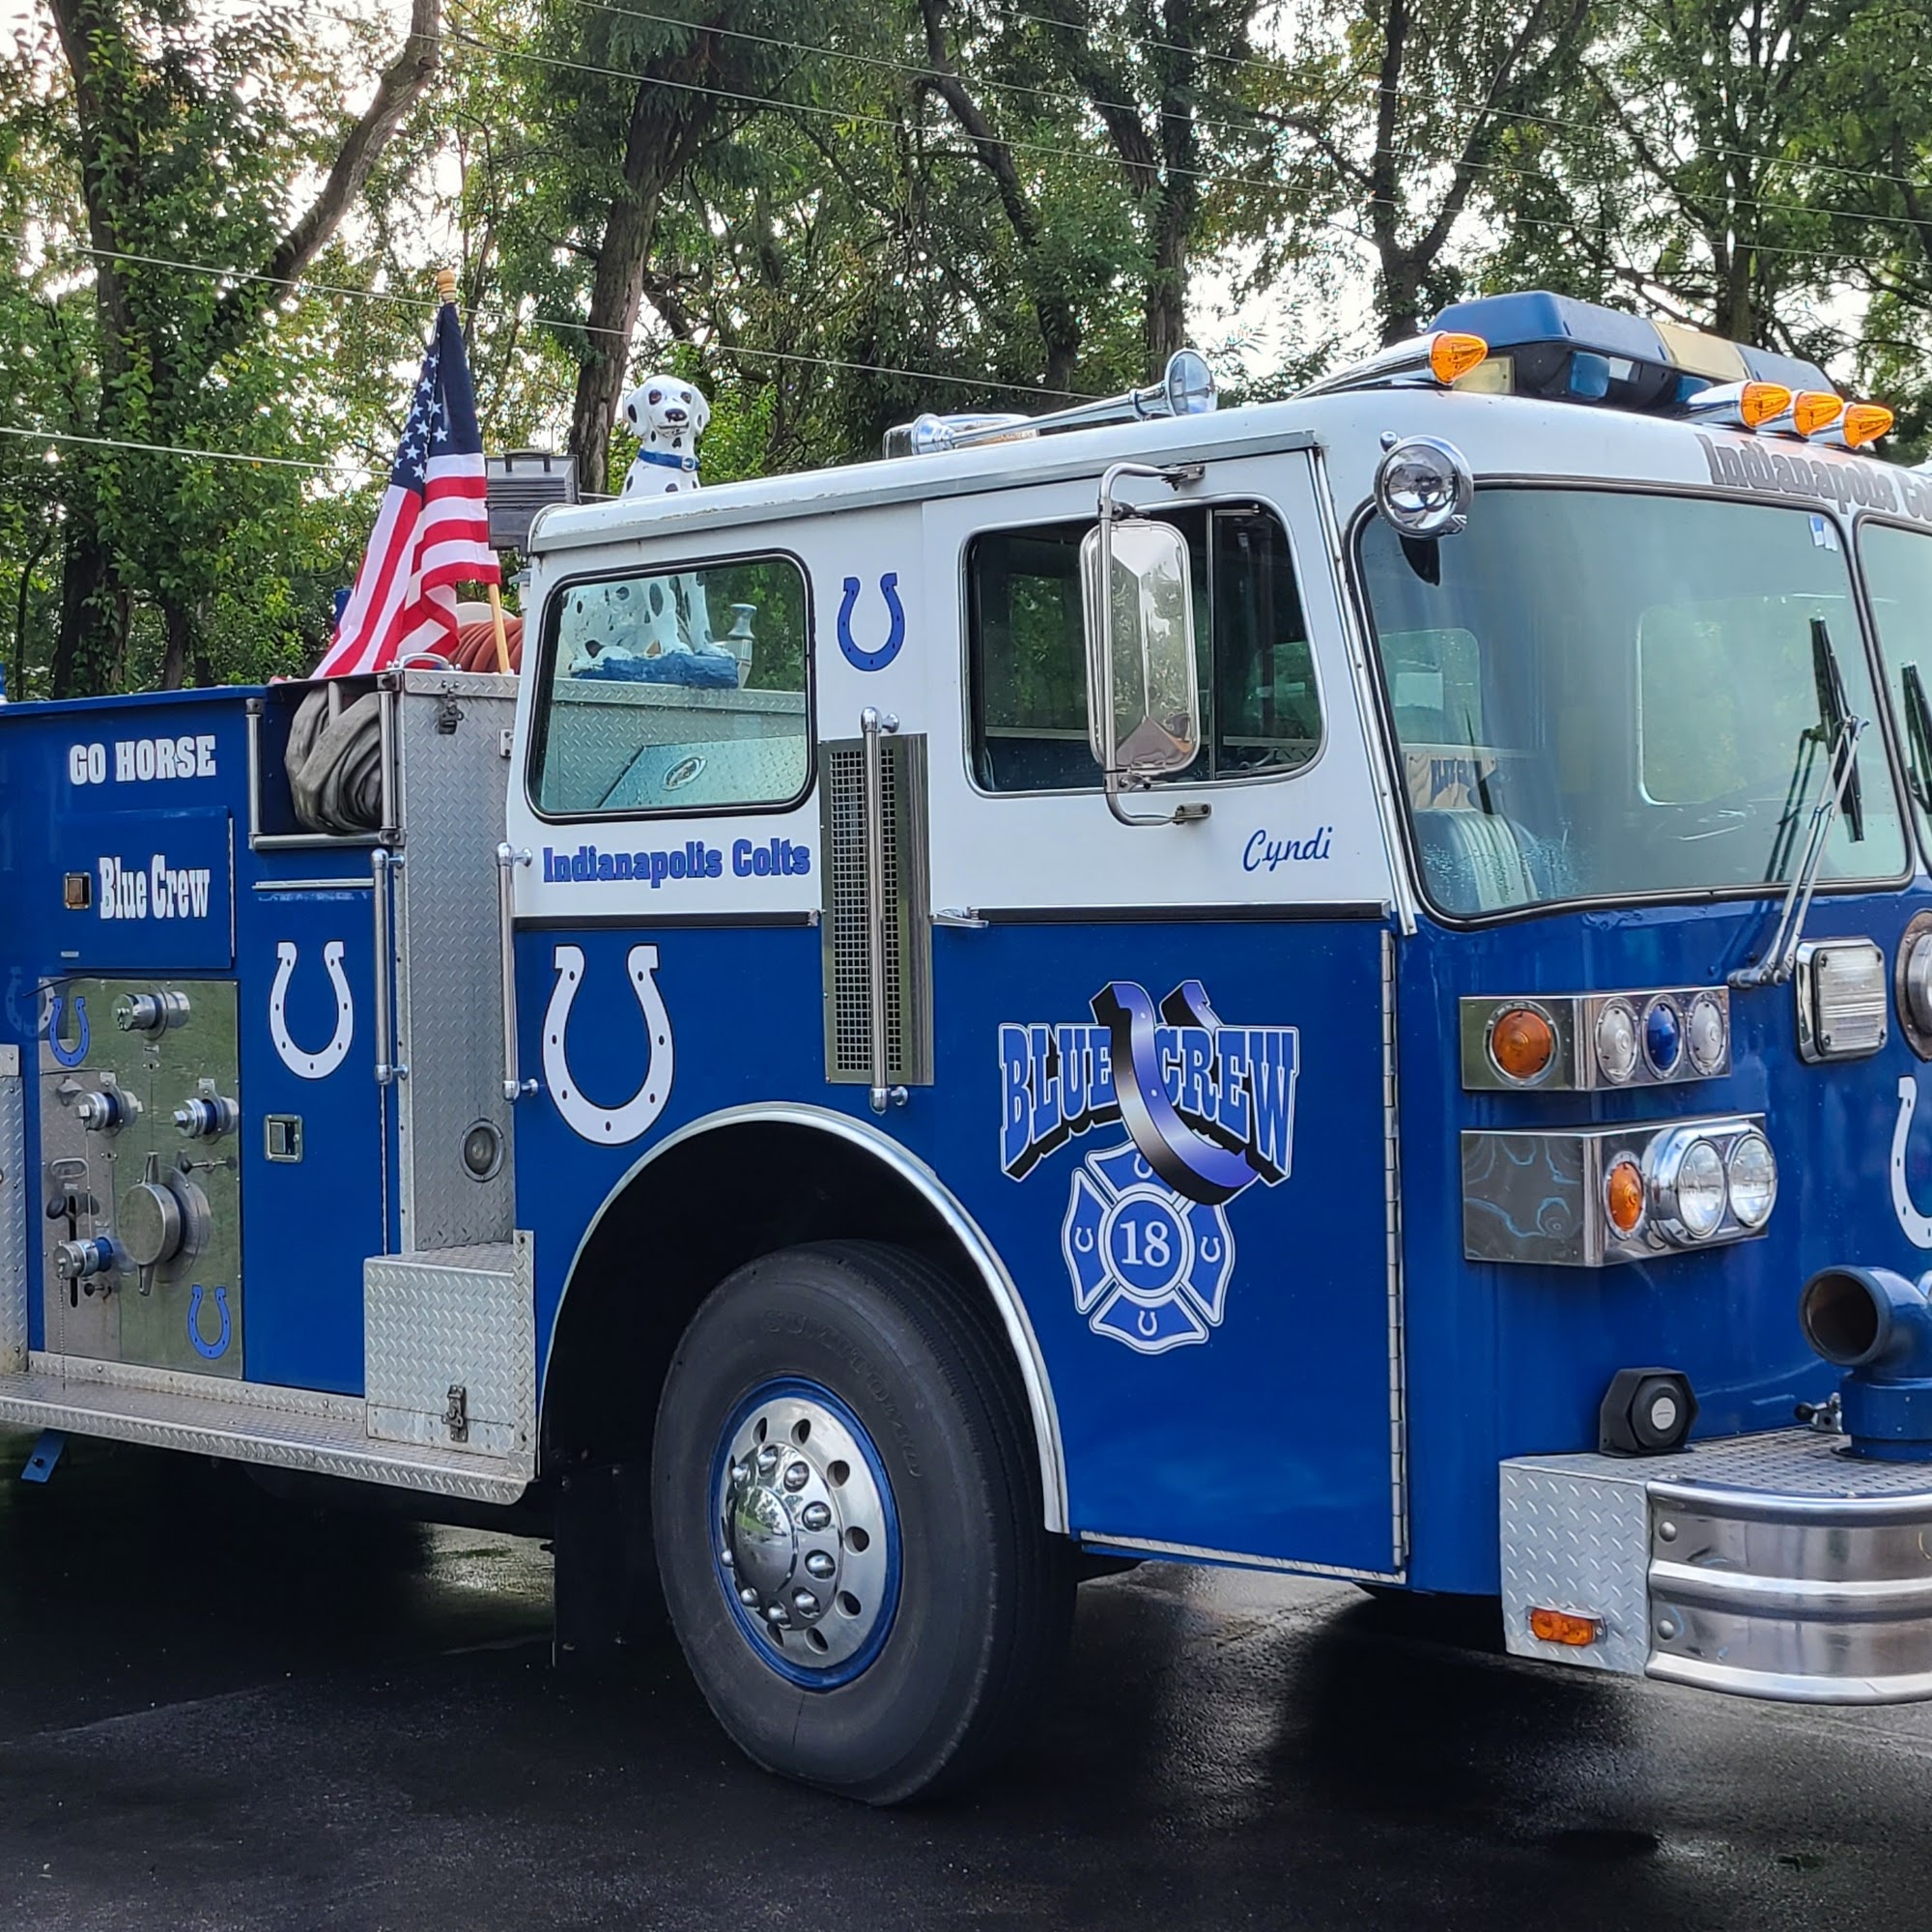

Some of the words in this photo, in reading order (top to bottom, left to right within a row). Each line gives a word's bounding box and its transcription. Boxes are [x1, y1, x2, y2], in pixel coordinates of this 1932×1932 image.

[1697, 435, 1897, 513] Indianapolis
[70, 743, 106, 785] GO
[115, 735, 216, 782] HORSE
[543, 839, 723, 889] Indianapolis
[732, 837, 810, 877] Colts
[1243, 826, 1333, 871] Cyndi
[99, 856, 147, 919] Blue
[151, 854, 210, 919] Crew
[1000, 1025, 1118, 1175] BLUE
[1155, 1025, 1299, 1180] CREW
[1120, 1220, 1171, 1267] 18
